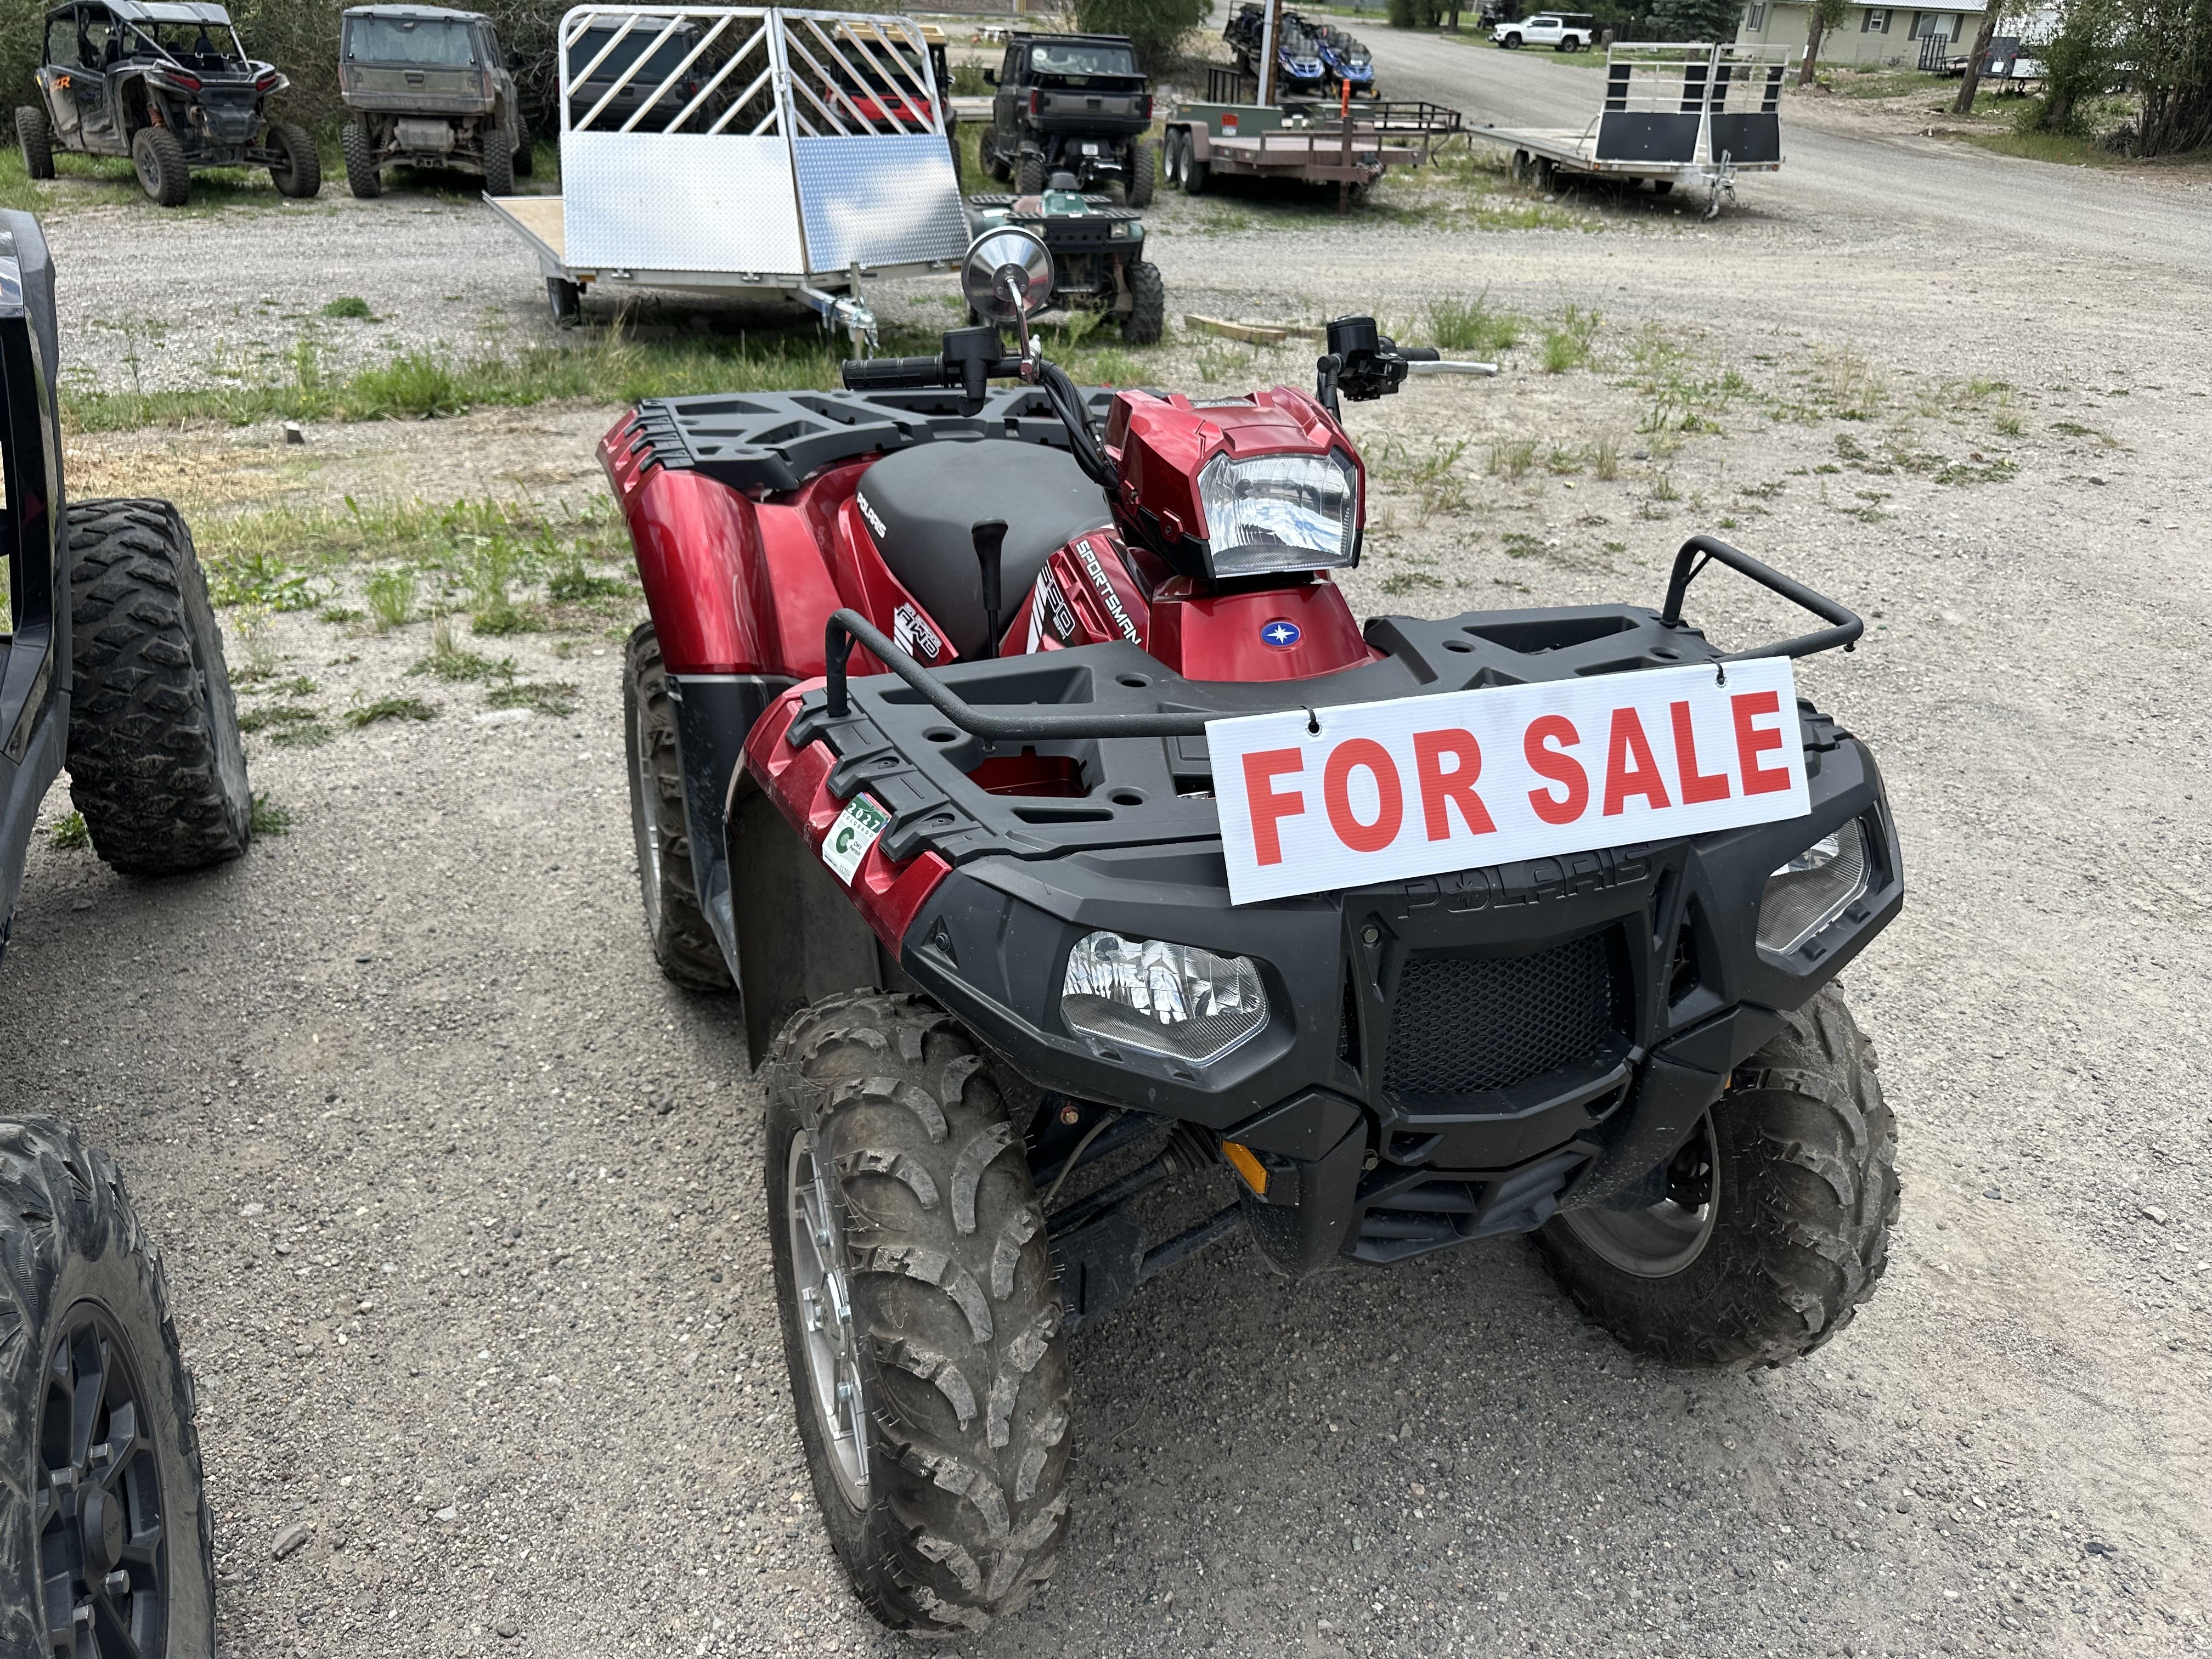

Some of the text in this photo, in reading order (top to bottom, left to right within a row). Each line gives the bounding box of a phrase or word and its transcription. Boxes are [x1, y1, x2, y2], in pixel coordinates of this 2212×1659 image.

[857, 492, 887, 538] POLARIS
[1076, 540, 1142, 645] SPORTSMAN
[896, 607, 939, 657] AWD
[1242, 690, 1791, 866] FOR SALE
[843, 813, 873, 838] COLORADO
[847, 803, 881, 832] 2027
[1397, 844, 1651, 919] POLARIS
